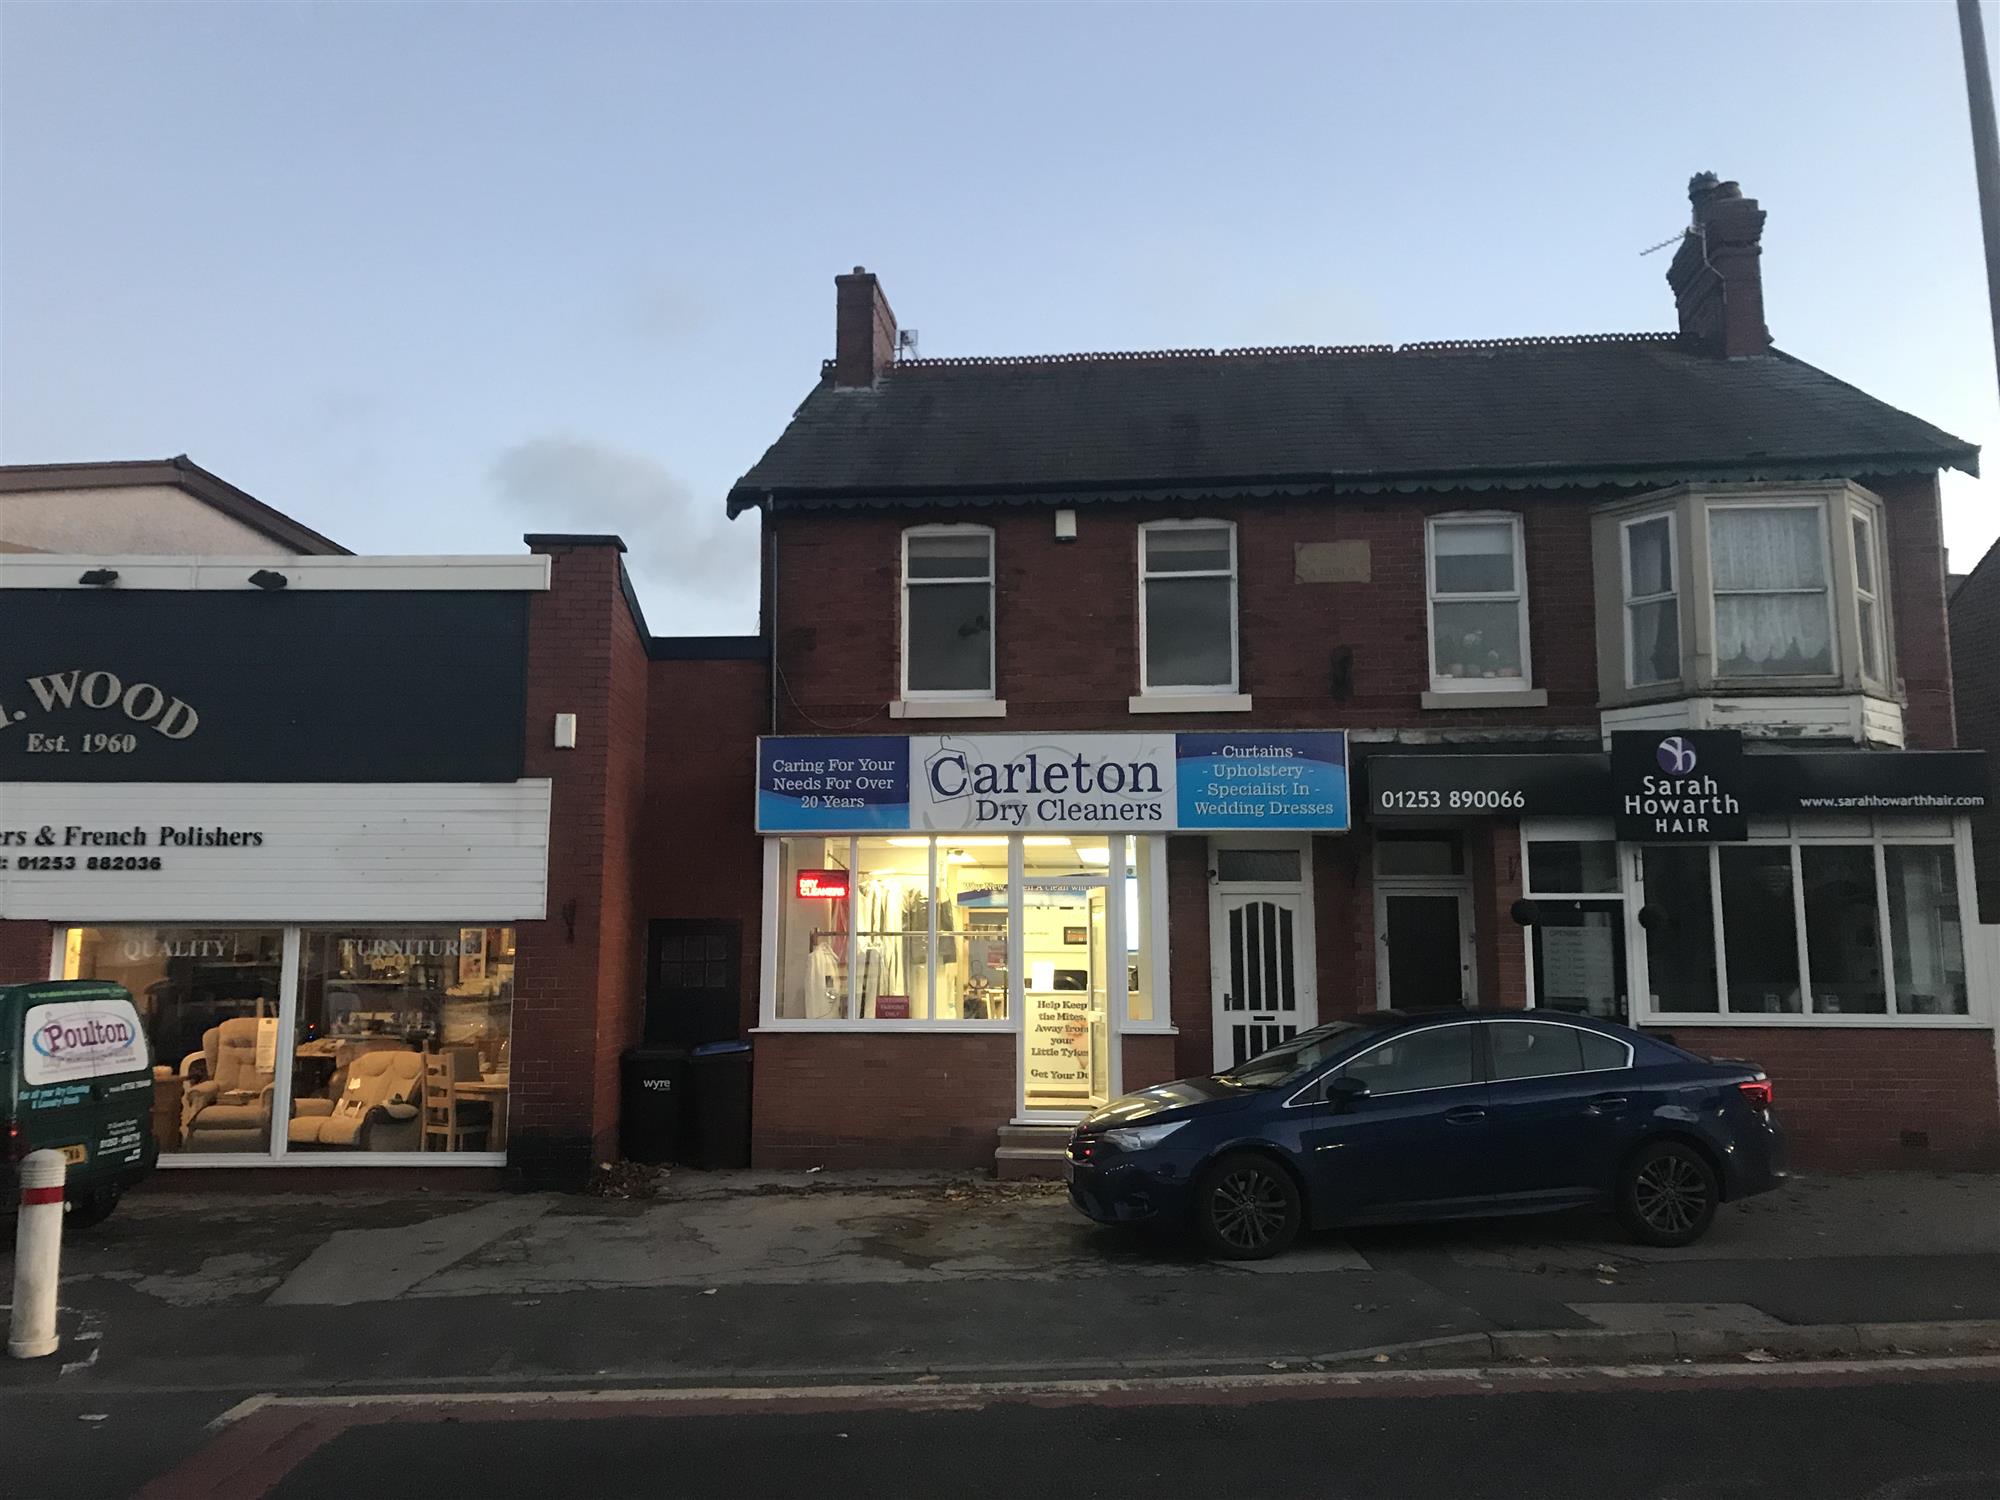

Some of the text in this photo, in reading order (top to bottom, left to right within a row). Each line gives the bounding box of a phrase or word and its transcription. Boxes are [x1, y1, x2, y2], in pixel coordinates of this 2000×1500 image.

[26, 670, 199, 739] WOOD
[26, 733, 137, 753] Est. 1960
[1222, 745, 1293, 758] Curtains
[772, 758, 895, 774] Caring For Your
[1213, 764, 1304, 779] Upholstery
[931, 753, 1163, 796] Carleton
[773, 776, 894, 791] Needs For Over
[1207, 783, 1310, 798] Specialist In
[1643, 775, 1718, 795] Sarah
[801, 795, 865, 809] 20 Years
[1381, 790, 1525, 808] 01253 890066
[1625, 794, 1739, 815] Howarth
[1800, 794, 1985, 807] www.sarahhowarthhair.com
[975, 799, 1163, 826] Dry Cleaners
[1194, 801, 1334, 817] Wedding Dresses
[1655, 818, 1710, 833] HAIR
[0, 825, 263, 847] rs & French Polishers
[18, 856, 76, 870] 01253
[87, 856, 162, 870] 882036
[124, 938, 478, 960] QUALITY FURNITURE
[1037, 1000, 1087, 1010] Help Keep
[43, 1020, 129, 1053] Poulton
[1035, 1024, 1064, 1034] Away
[1050, 1038, 1074, 1046] your
[1031, 1047, 1059, 1057] Little
[1030, 1069, 1048, 1078] Get
[1050, 1070, 1075, 1080] Your
[643, 1080, 670, 1090] wyre
